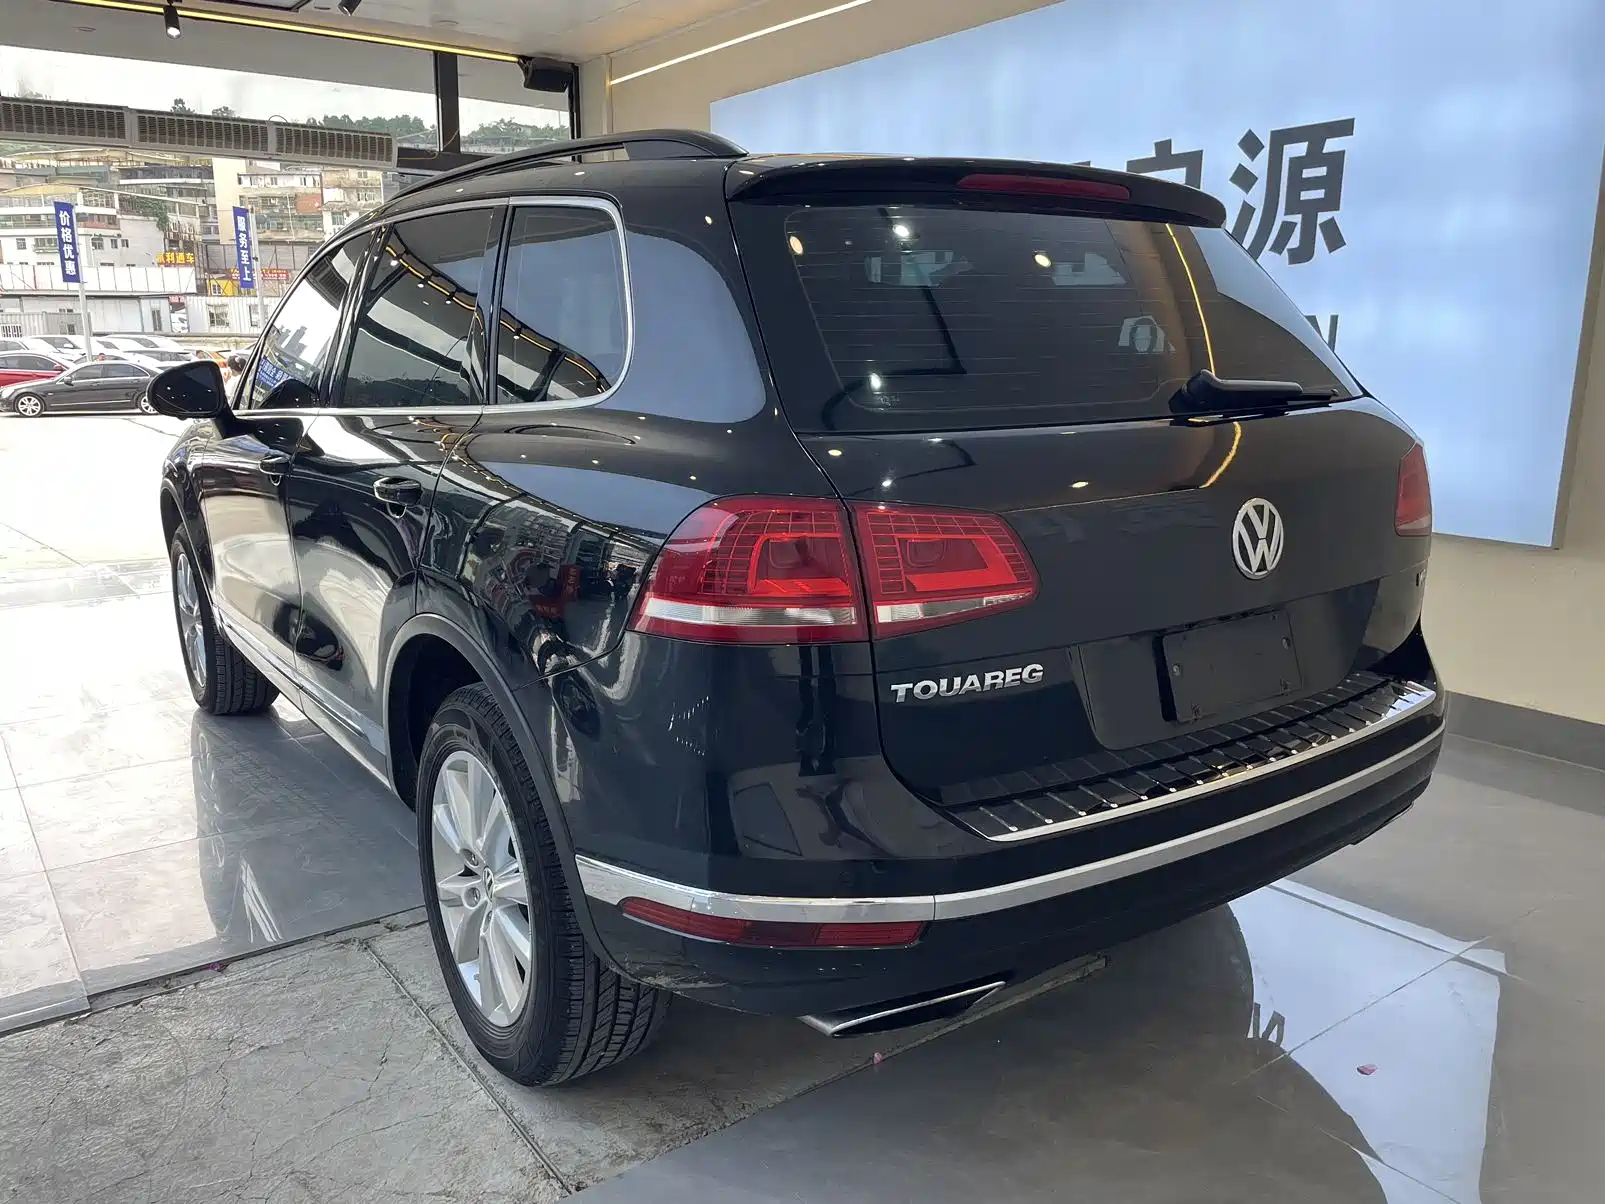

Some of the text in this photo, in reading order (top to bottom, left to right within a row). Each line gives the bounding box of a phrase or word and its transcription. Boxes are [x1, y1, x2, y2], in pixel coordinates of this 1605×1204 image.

[59, 210, 76, 276] 价格优惠
[237, 215, 252, 282] 服务至上
[891, 663, 1044, 703] TOUAREG
